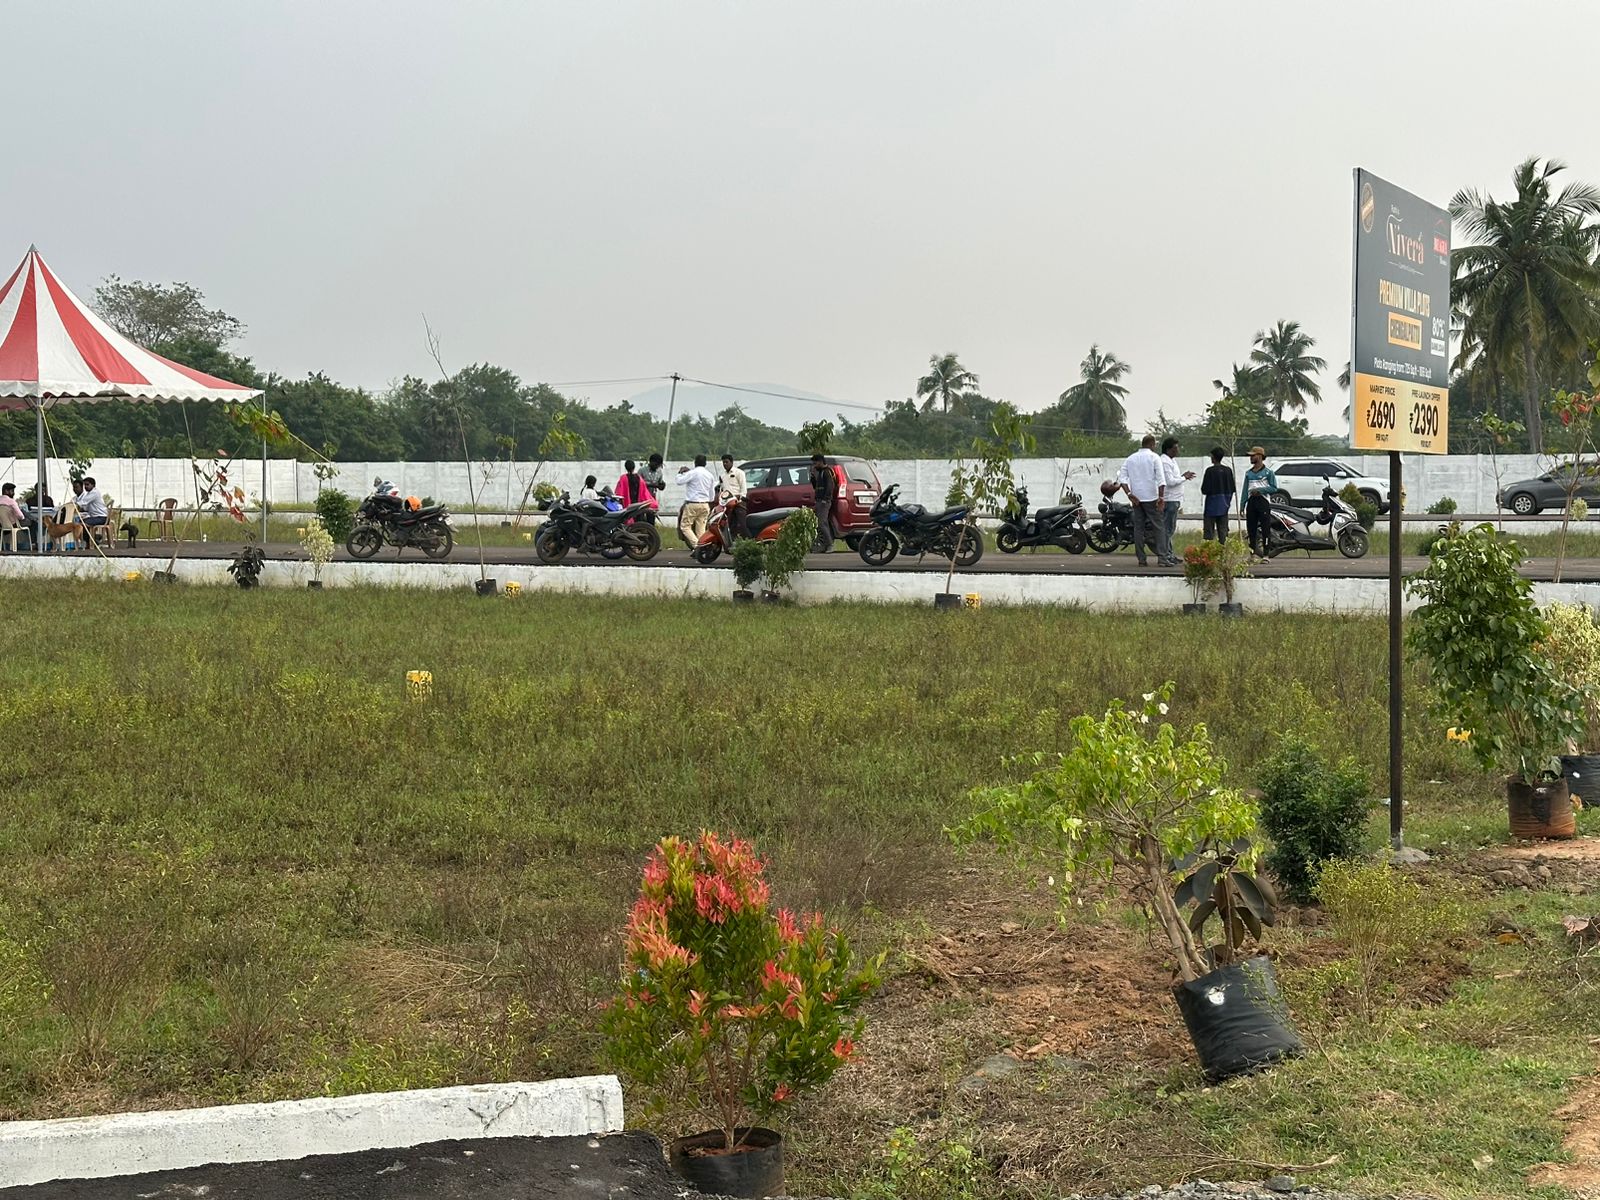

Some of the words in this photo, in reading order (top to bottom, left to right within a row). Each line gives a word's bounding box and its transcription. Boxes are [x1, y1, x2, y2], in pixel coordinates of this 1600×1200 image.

[1379, 279, 1404, 309] PREMIUM
[1404, 286, 1417, 313] VILLA
[1417, 291, 1430, 317] PLOTS
[1432, 316, 1445, 338] 80%
[1370, 384, 1384, 394] MARKET
[1385, 386, 1396, 397] PRICE
[1366, 399, 1396, 430] ₹2690
[1409, 402, 1439, 437] ₹2390
